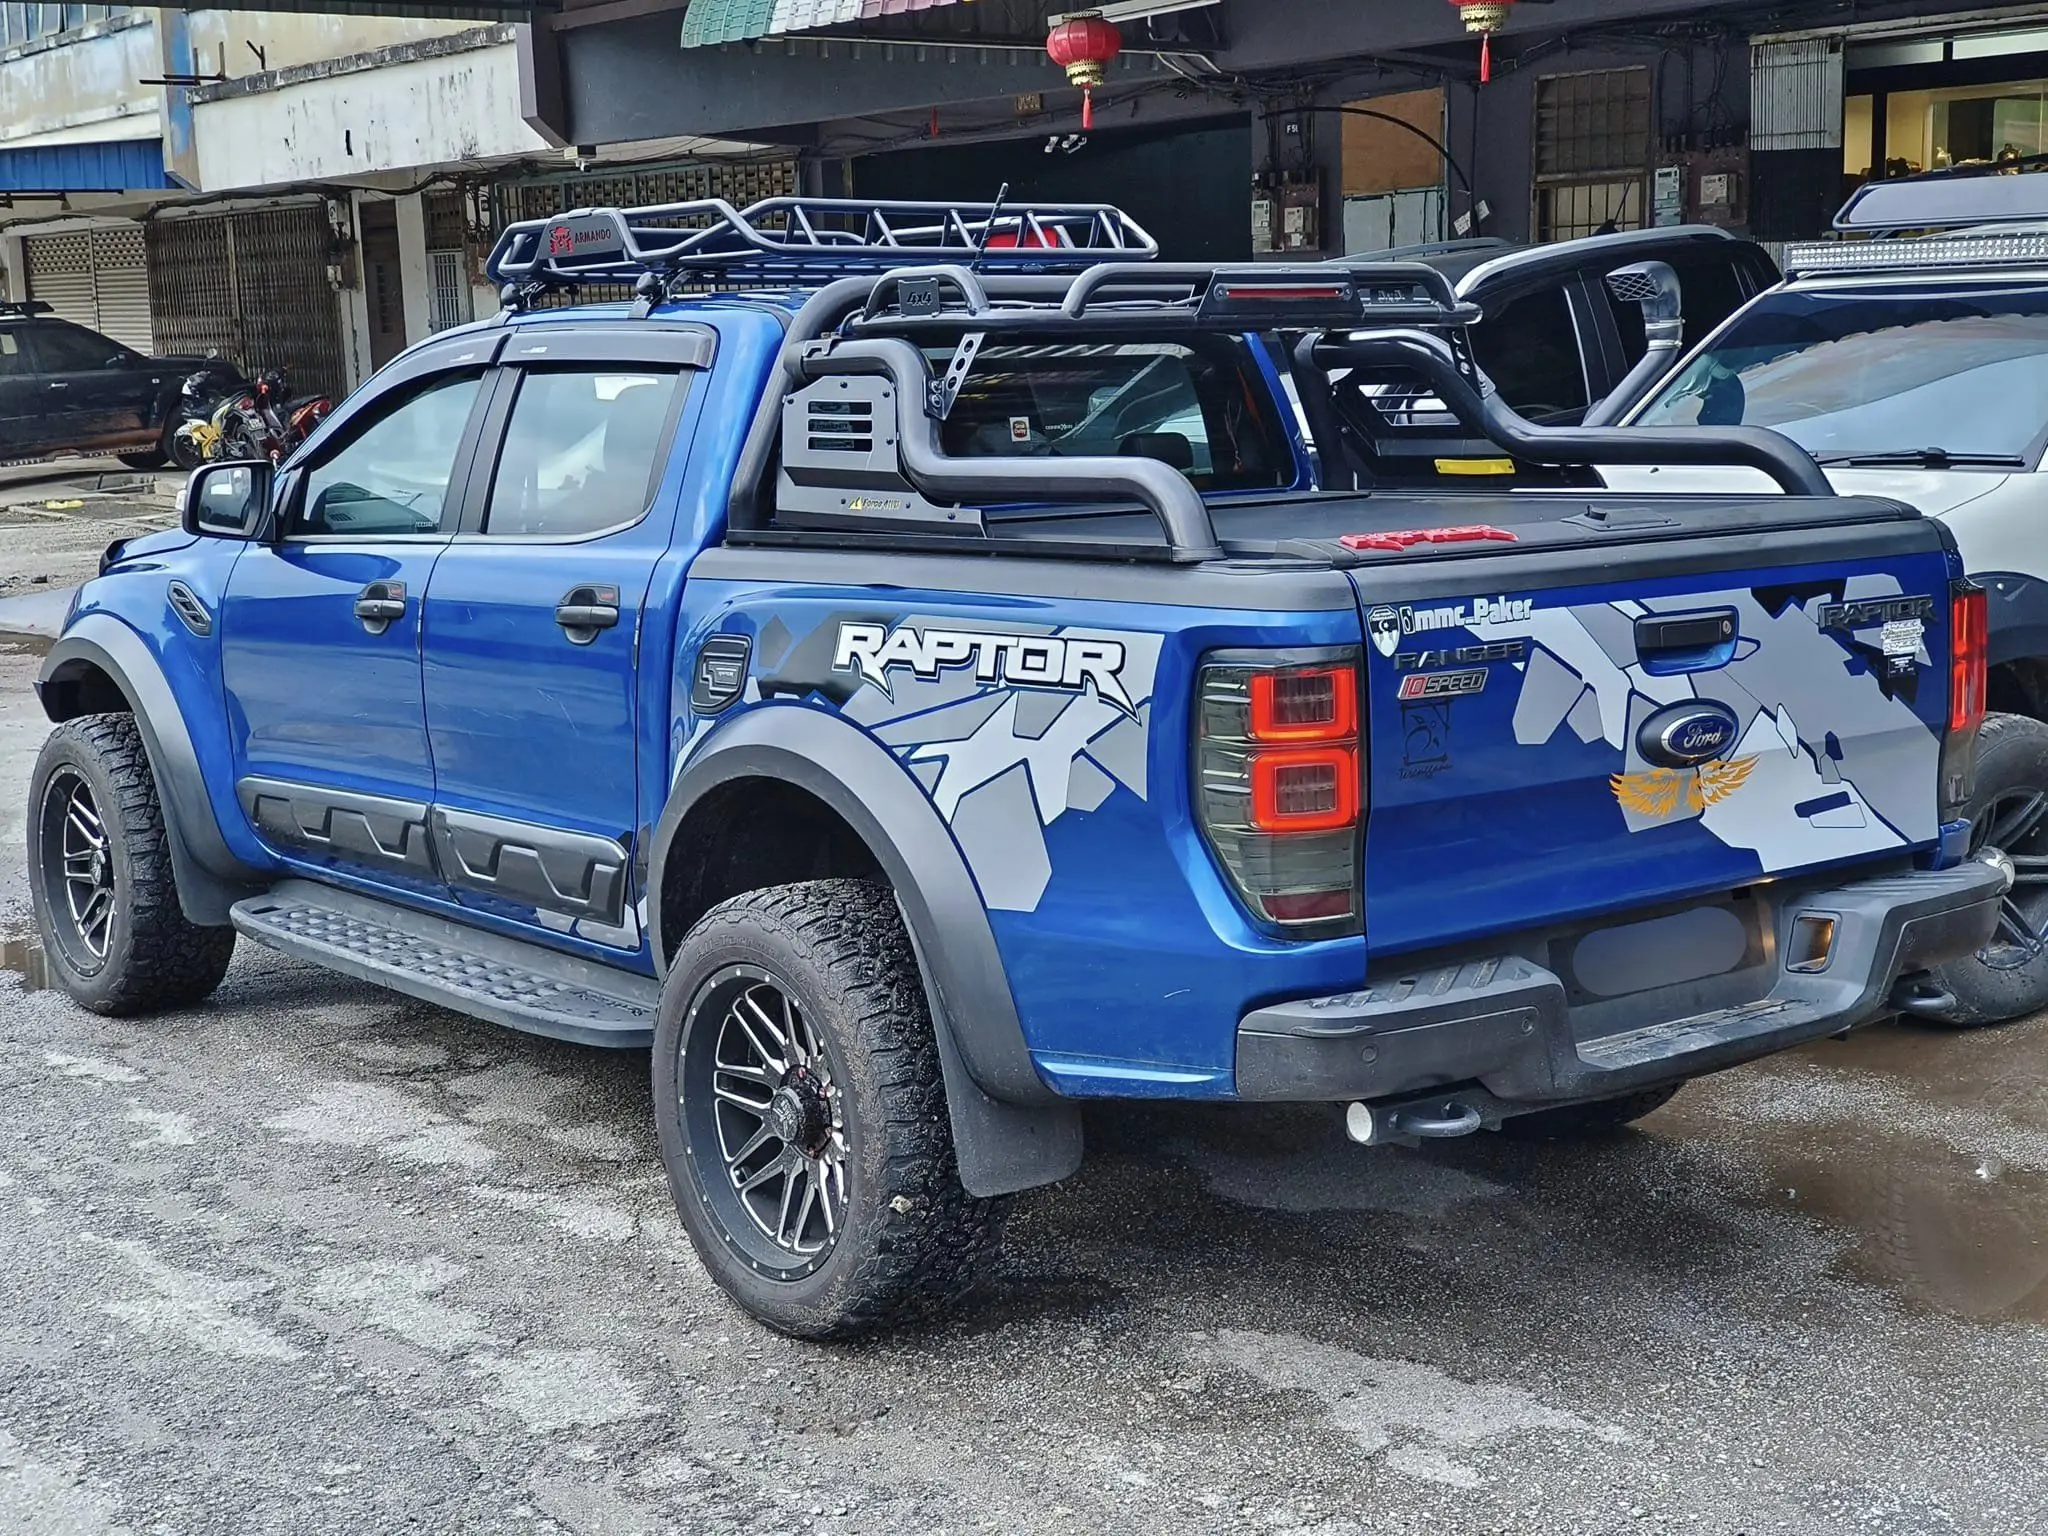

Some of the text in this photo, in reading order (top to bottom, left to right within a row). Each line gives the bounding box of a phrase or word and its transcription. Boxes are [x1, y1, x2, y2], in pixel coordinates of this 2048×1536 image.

[575, 229, 611, 243] ARMANDO
[1394, 641, 1524, 671] RANGER
[834, 622, 1140, 726] RAPTOR
[1425, 673, 1484, 693] SPEED
[1684, 722, 1723, 748] Ford
